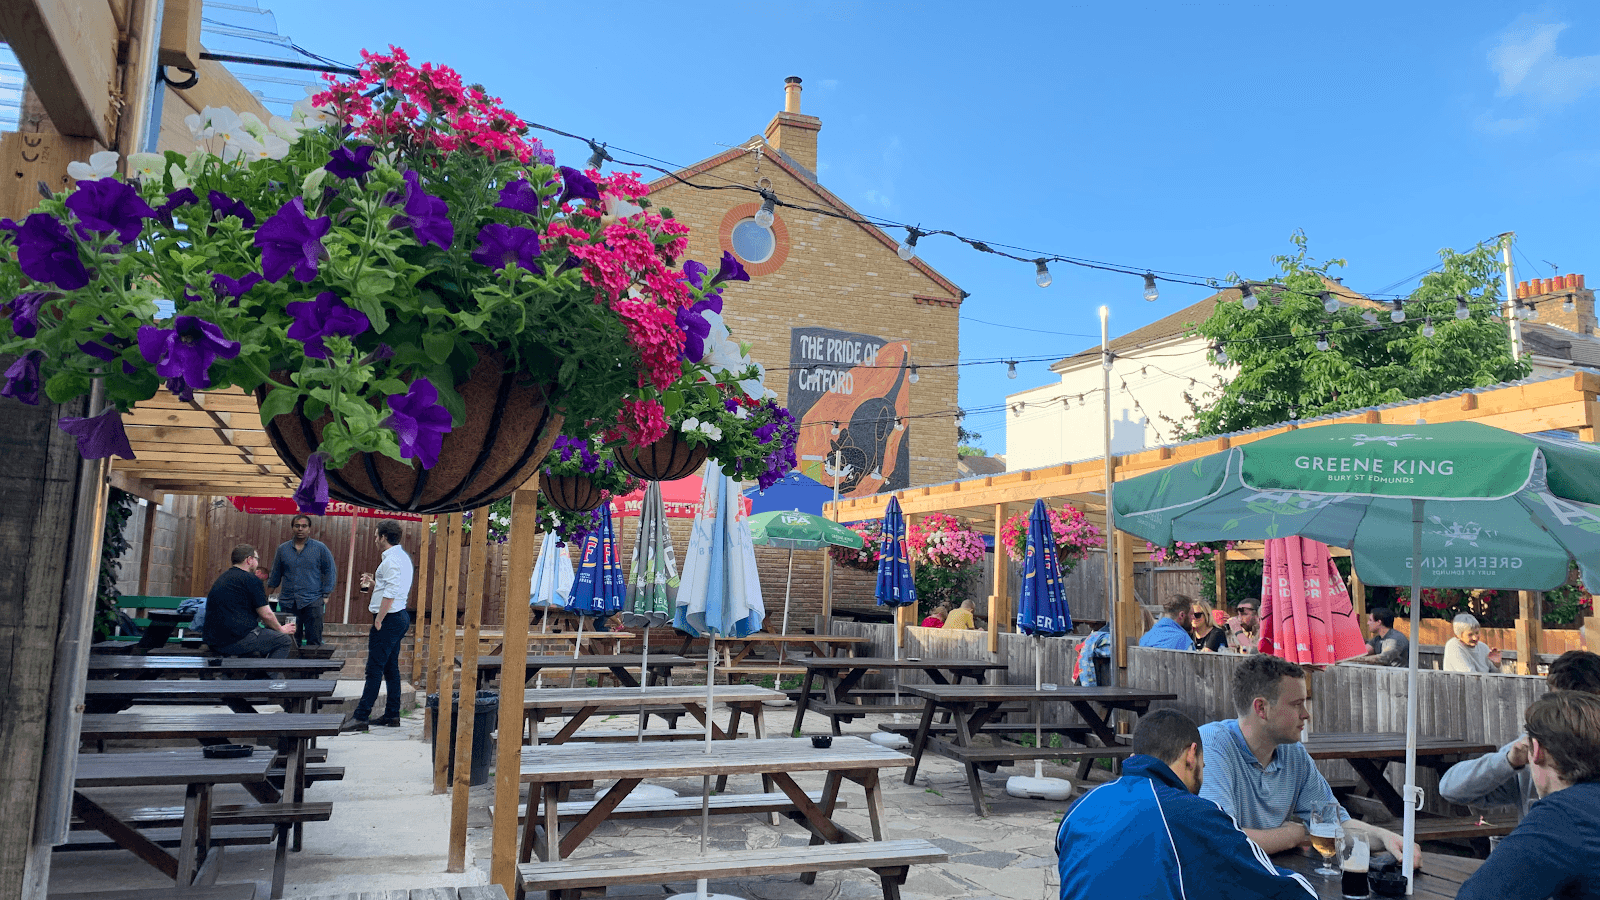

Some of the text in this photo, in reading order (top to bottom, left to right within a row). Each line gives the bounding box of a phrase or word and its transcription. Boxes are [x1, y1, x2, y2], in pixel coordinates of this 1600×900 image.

[800, 335, 880, 367] THE PRIDE OF
[1295, 456, 1454, 476] GREENE KING
[1368, 475, 1414, 484] EDMUNDS
[781, 515, 811, 525] IPA
